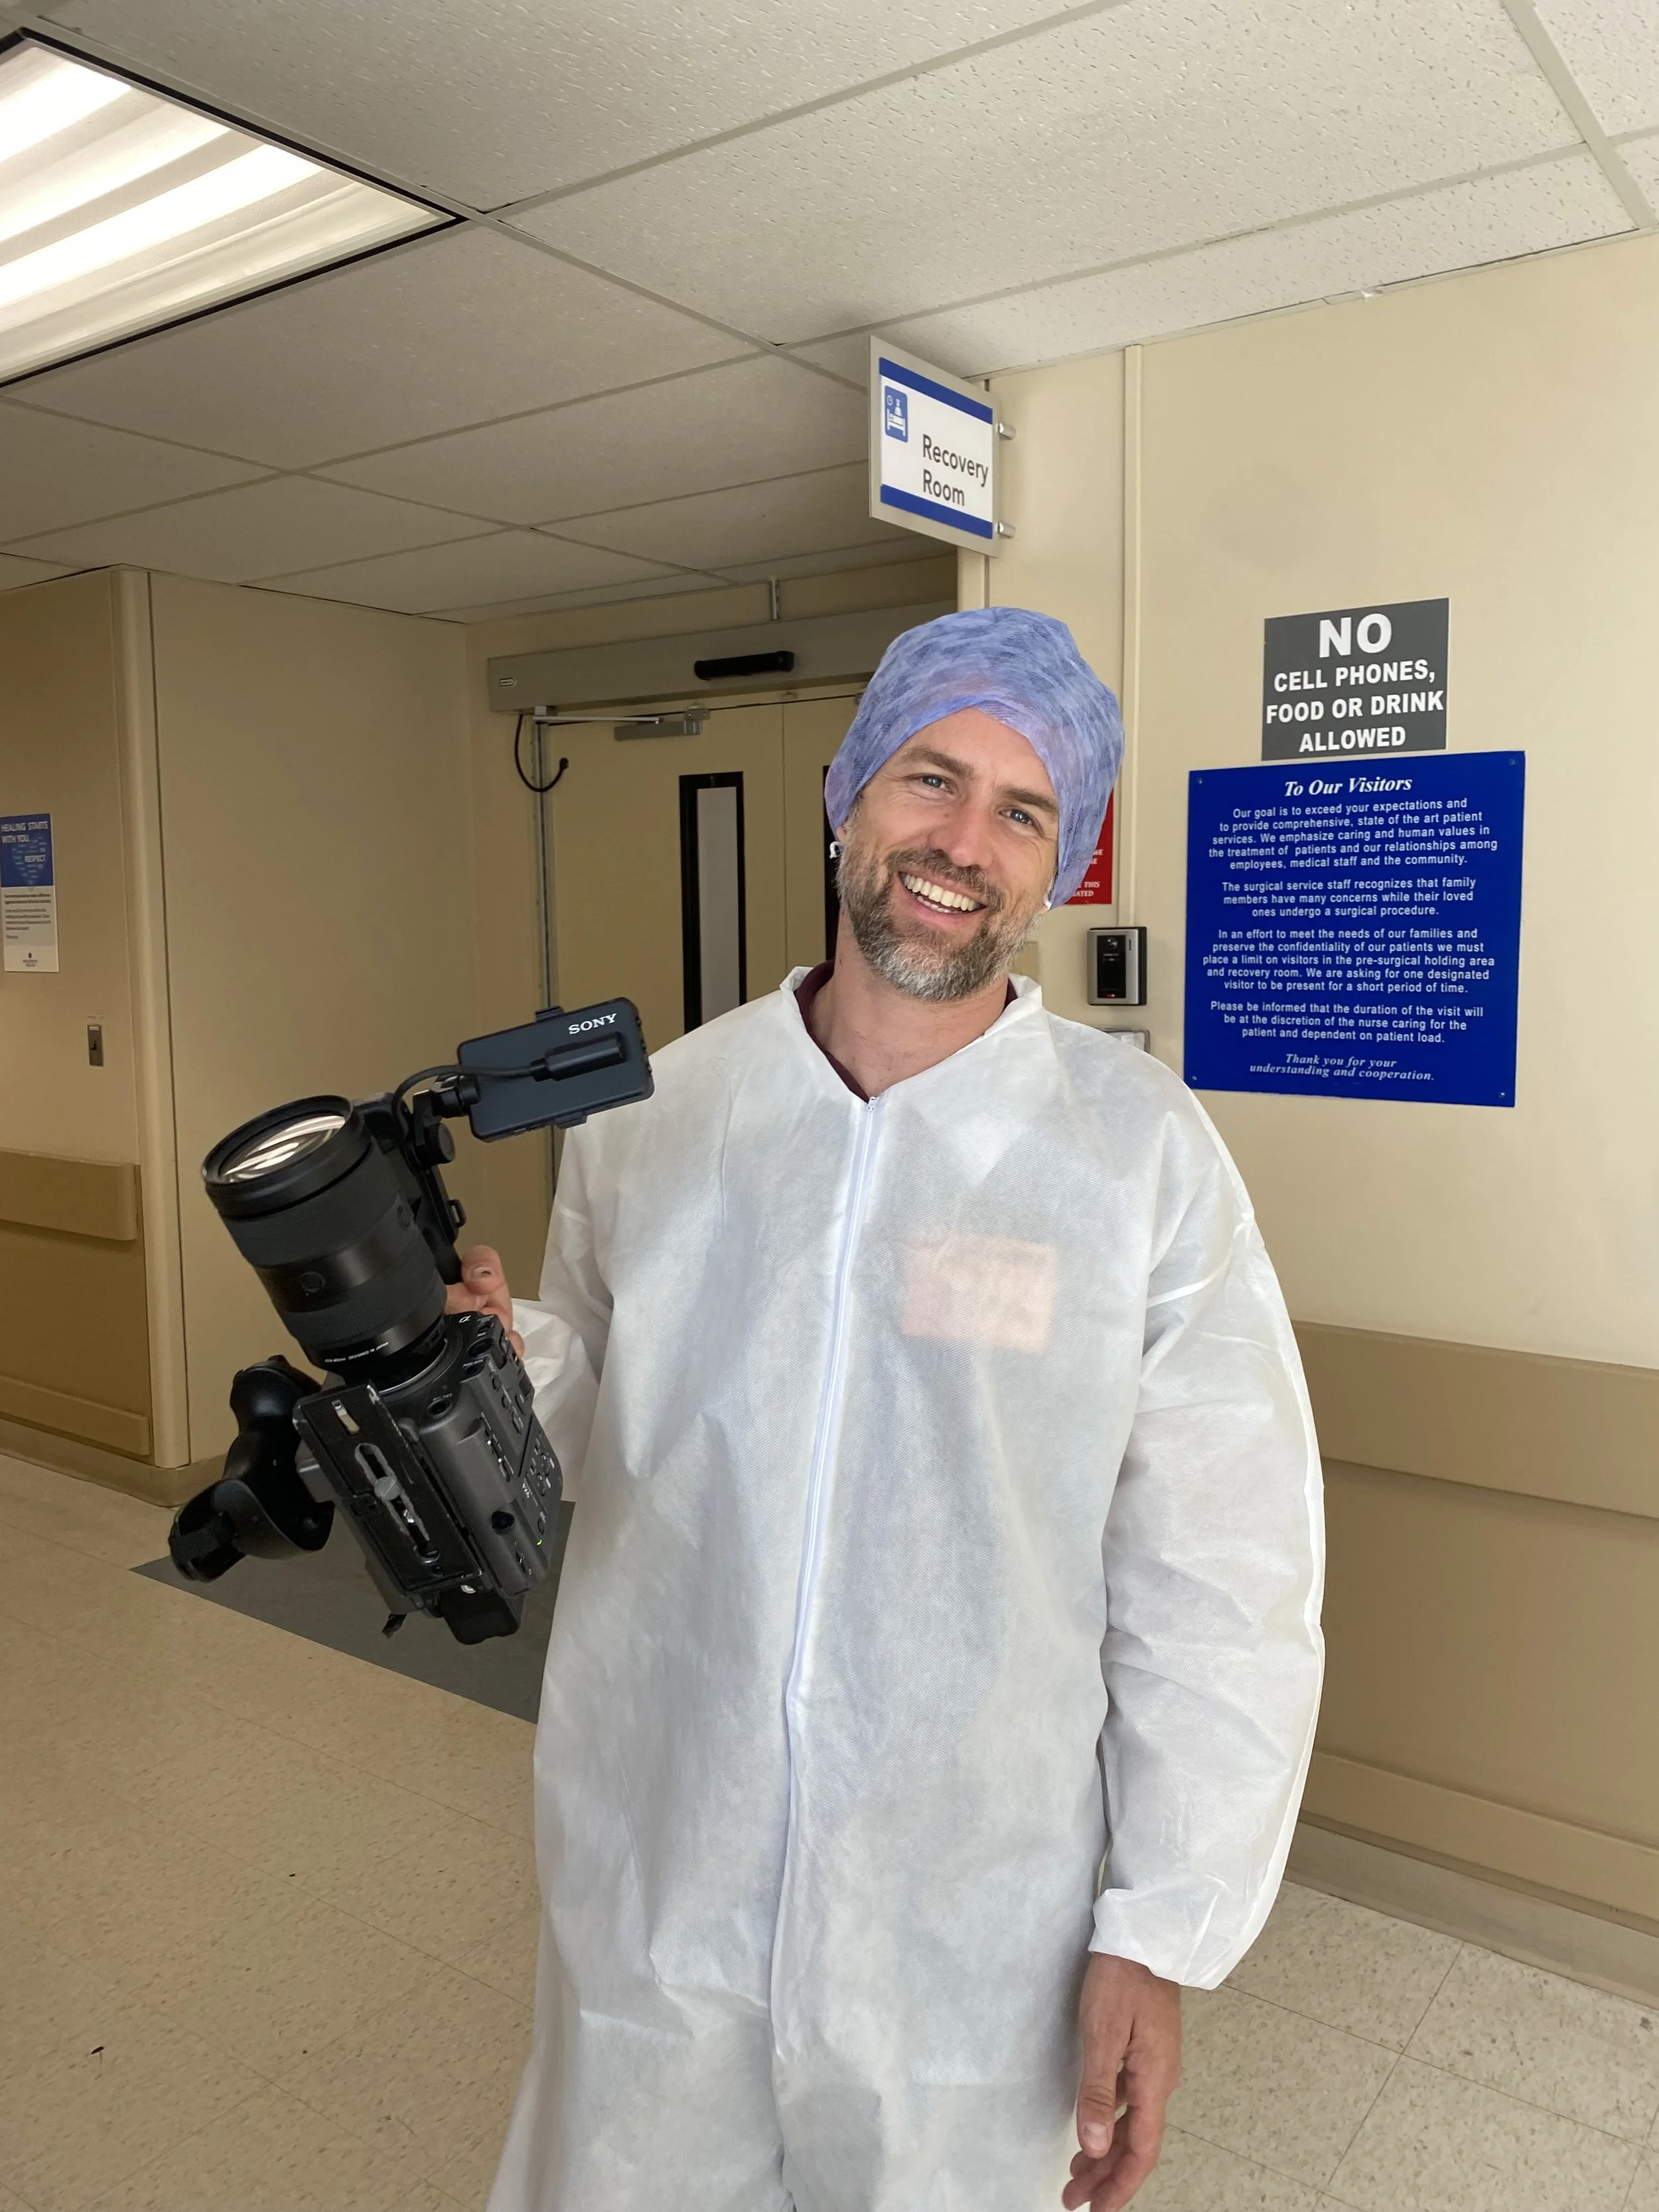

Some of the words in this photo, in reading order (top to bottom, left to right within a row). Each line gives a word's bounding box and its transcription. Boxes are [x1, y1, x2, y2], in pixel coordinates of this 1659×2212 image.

[922, 433, 988, 487] Recovery
[923, 469, 964, 506] Room
[1319, 613, 1392, 658] NO
[1274, 670, 1327, 692] CELL
[1335, 659, 1435, 686] PHONES,
[1266, 701, 1324, 724] FOOD
[1332, 697, 1363, 719] OR
[1371, 690, 1444, 715] DRINK
[1299, 726, 1406, 753] ALLOWED
[1284, 781, 1303, 796] To
[1308, 779, 1343, 795] Our
[1348, 776, 1413, 792] Visitors
[1233, 808, 1252, 818] Our
[1254, 807, 1275, 819] goal
[1279, 806, 1288, 816] is
[1291, 806, 1301, 815] to
[1305, 803, 1342, 815] exceed
[1345, 804, 1370, 815] your
[1372, 800, 1443, 813] expectations
[1446, 797, 1467, 808] and
[1220, 822, 1229, 832] to
[1232, 820, 1269, 833] provide
[1272, 818, 1353, 830] comprehensive,
[1357, 816, 1384, 826] state
[1388, 814, 1400, 824] of
[1402, 814, 1419, 824] the
[1423, 813, 1439, 823] art
[1443, 812, 1482, 824] patient
[1212, 835, 1256, 845] services.
[1260, 833, 1275, 842] We
[1279, 831, 1334, 844] emphasize
[1338, 830, 1370, 842] caring
[1374, 828, 1394, 838] and
[1398, 828, 1435, 838] human
[1438, 826, 1475, 836] values
[1479, 825, 1490, 835] in
[1208, 848, 1224, 857] the
[1227, 846, 1275, 857] treatment
[1277, 845, 1289, 855] of
[1295, 844, 1336, 857] patients
[1340, 843, 1360, 853] and
[1384, 840, 1456, 852] relationships
[1459, 840, 1498, 851] among
[1230, 859, 1286, 871] employees,
[1290, 857, 1330, 867] medical
[1333, 856, 1357, 867] staff
[1360, 855, 1380, 865] and
[1384, 855, 1401, 865] the
[1405, 853, 1467, 865] community.
[1222, 882, 1240, 891] The
[1244, 881, 1283, 893] surgical
[1287, 880, 1323, 890] service
[1327, 879, 1351, 889] staff
[1354, 878, 1413, 891] recognizes
[1417, 877, 1438, 887] that
[1442, 877, 1477, 889] family
[1224, 895, 1267, 904] members
[1271, 894, 1295, 903] have
[1299, 895, 1327, 905] many
[1330, 894, 1378, 903] concerns
[1382, 891, 1410, 902] while
[1413, 891, 1439, 901] their
[1443, 891, 1473, 901] loved
[1279, 907, 1321, 919] undergo
[1334, 905, 1376, 918] surgical
[1380, 905, 1439, 917] procedure.
[1218, 929, 1228, 938] In
[1246, 928, 1273, 938] effort
[1276, 929, 1286, 938] to
[1289, 929, 1315, 938] meet
[1318, 928, 1334, 938] the
[1338, 928, 1370, 938] needs
[1374, 928, 1384, 938] of
[1409, 928, 1453, 938] families
[1457, 928, 1478, 938] and
[1212, 944, 1255, 953] preserve
[1258, 942, 1274, 951] the
[1277, 941, 1350, 954] confidentiality
[1354, 941, 1364, 952] of
[1389, 942, 1433, 954] patients
[1457, 942, 1484, 952] must
[1203, 954, 1228, 966] place
[1242, 954, 1262, 964] limit
[1281, 955, 1319, 964] visitors
[1323, 955, 1332, 964] in
[1335, 955, 1352, 964] the
[1356, 955, 1420, 968] pre-surgical
[1424, 955, 1465, 968] holding
[1207, 967, 1224, 976] and
[1228, 969, 1270, 979] recovery
[1306, 968, 1322, 978] We
[1346, 968, 1381, 980] asking
[1385, 968, 1400, 978] for
[1403, 970, 1423, 979] one
[1427, 969, 1489, 982] designated
[1224, 980, 1254, 990] visitor
[1258, 981, 1267, 990] to
[1271, 980, 1283, 990] be
[1286, 981, 1325, 992] present
[1329, 981, 1343, 991] for
[1356, 981, 1384, 992] short
[1388, 982, 1421, 994] period
[1425, 982, 1437, 992] of
[1441, 983, 1468, 993] time.
[1210, 1001, 1243, 1011] Please
[1247, 1001, 1259, 1011] be
[1262, 1001, 1306, 1012] informed
[1309, 1003, 1330, 1013] that
[1333, 1003, 1350, 1013] the
[1353, 1004, 1398, 1015] duration
[1401, 1005, 1412, 1015] of
[1415, 1005, 1433, 1015] the
[1437, 1005, 1461, 1016] visit
[1464, 1007, 1483, 1017] will
[568, 1013, 618, 1035] SONY
[1224, 1013, 1236, 1023] be
[1239, 1015, 1249, 1023] at
[1252, 1015, 1267, 1024] the
[1271, 1015, 1321, 1025] discretion
[1324, 1016, 1334, 1026] of
[1338, 1017, 1354, 1027] the
[1358, 1019, 1388, 1027] nurse
[1392, 1019, 1426, 1031] caring
[1430, 1019, 1445, 1029] for
[1449, 1019, 1467, 1030] the
[1242, 1027, 1276, 1038] patient
[1279, 1029, 1298, 1038] and
[1301, 1029, 1356, 1040] dependent
[1376, 1031, 1413, 1043] patient
[1417, 1032, 1445, 1043] load.
[1286, 1053, 1319, 1064] Thank
[1322, 1058, 1344, 1067] you
[1346, 1056, 1366, 1068] for
[1367, 1060, 1397, 1069] your
[1250, 1063, 1329, 1078] understanding
[1333, 1067, 1356, 1076] and
[1358, 1070, 1433, 1080] cooperation.
